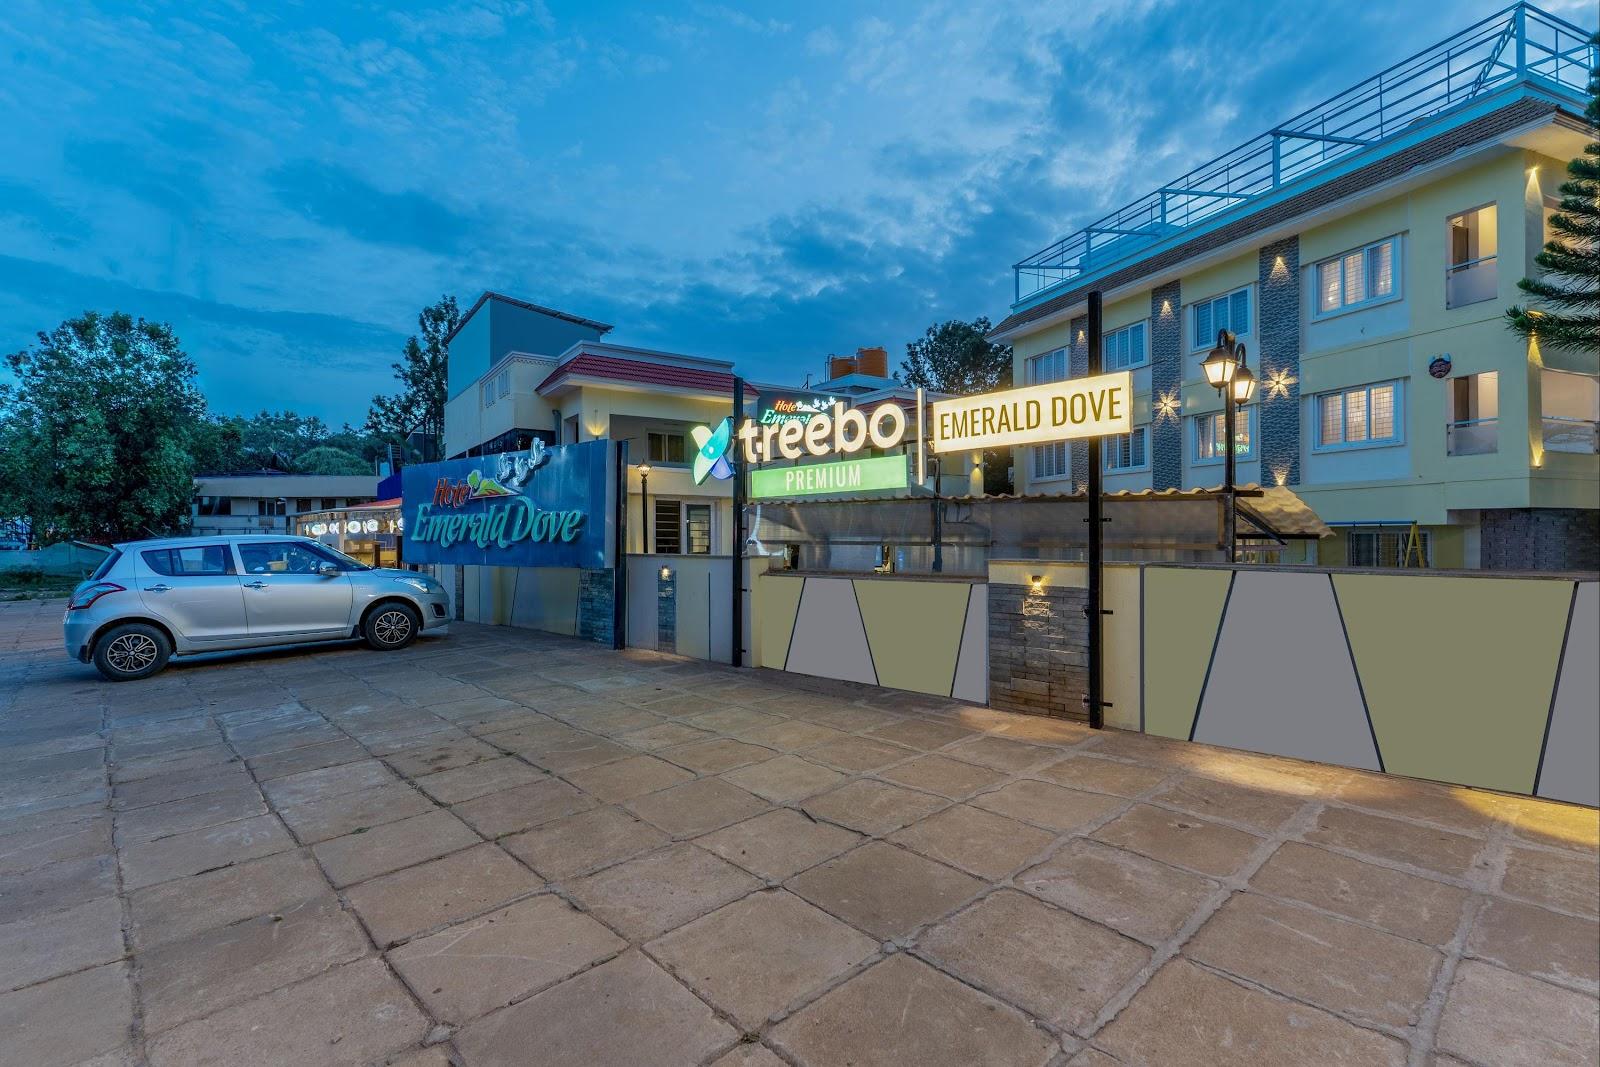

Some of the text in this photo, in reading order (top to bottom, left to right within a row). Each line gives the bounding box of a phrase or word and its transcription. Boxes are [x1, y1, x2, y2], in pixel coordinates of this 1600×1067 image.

[738, 401, 906, 464] treebo
[940, 387, 1122, 441] EMERALD DOVE
[786, 463, 861, 491] PREMIUM
[410, 496, 582, 549] Emerald Dove
